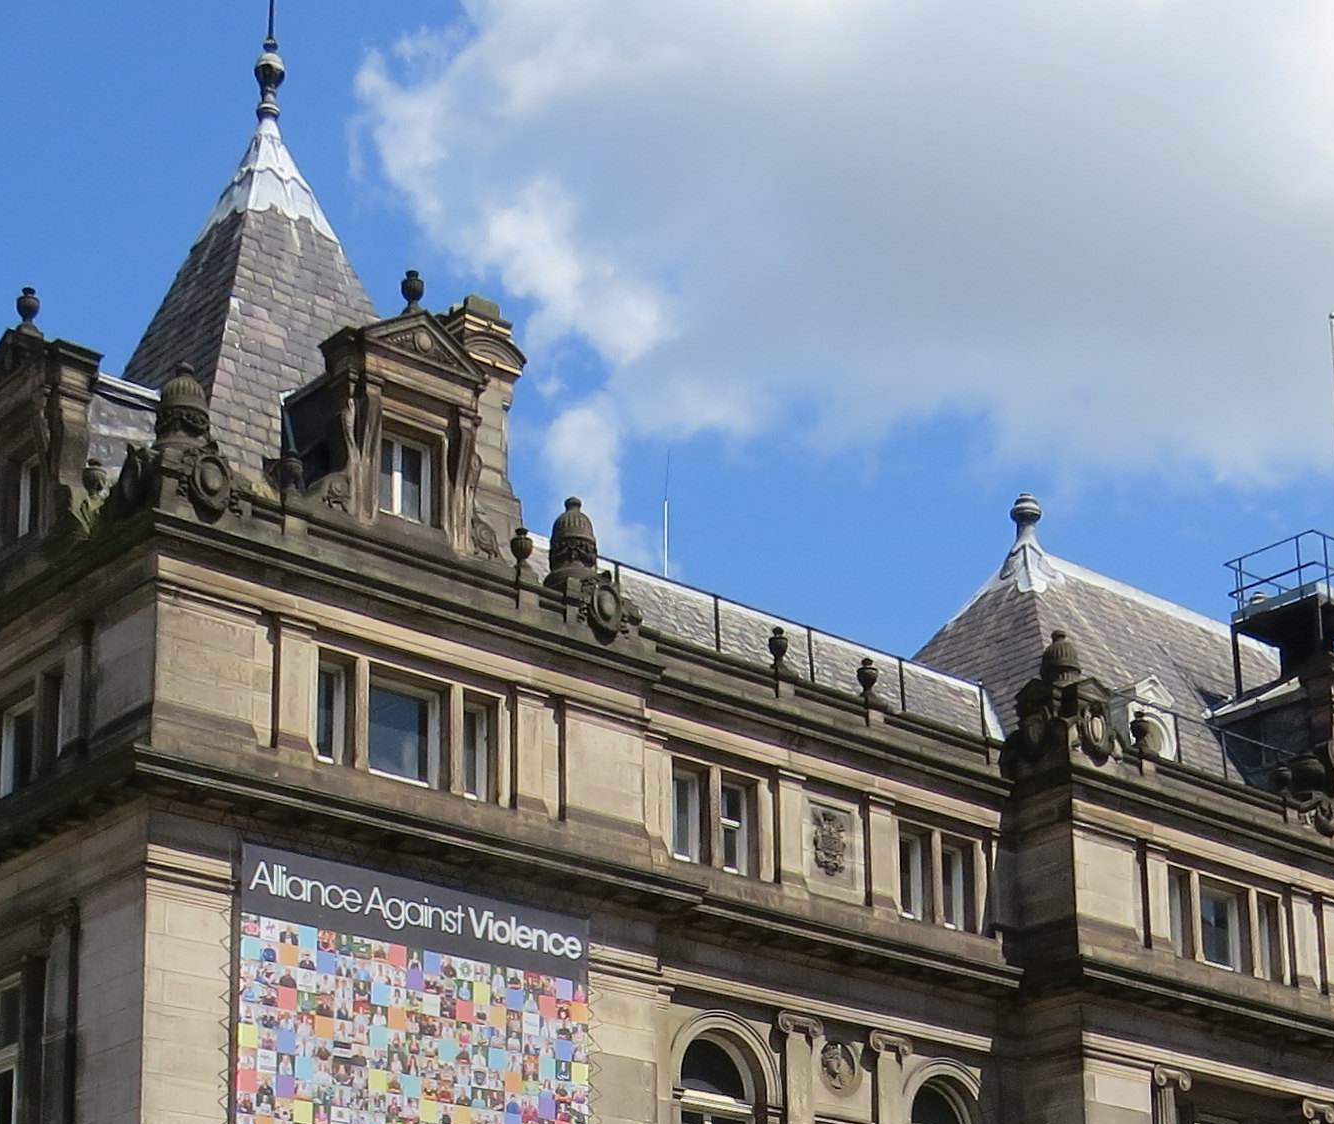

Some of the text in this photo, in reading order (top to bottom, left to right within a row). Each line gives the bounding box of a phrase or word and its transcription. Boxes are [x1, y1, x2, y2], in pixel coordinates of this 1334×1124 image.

[249, 860, 583, 961] Alliance Against Violence
